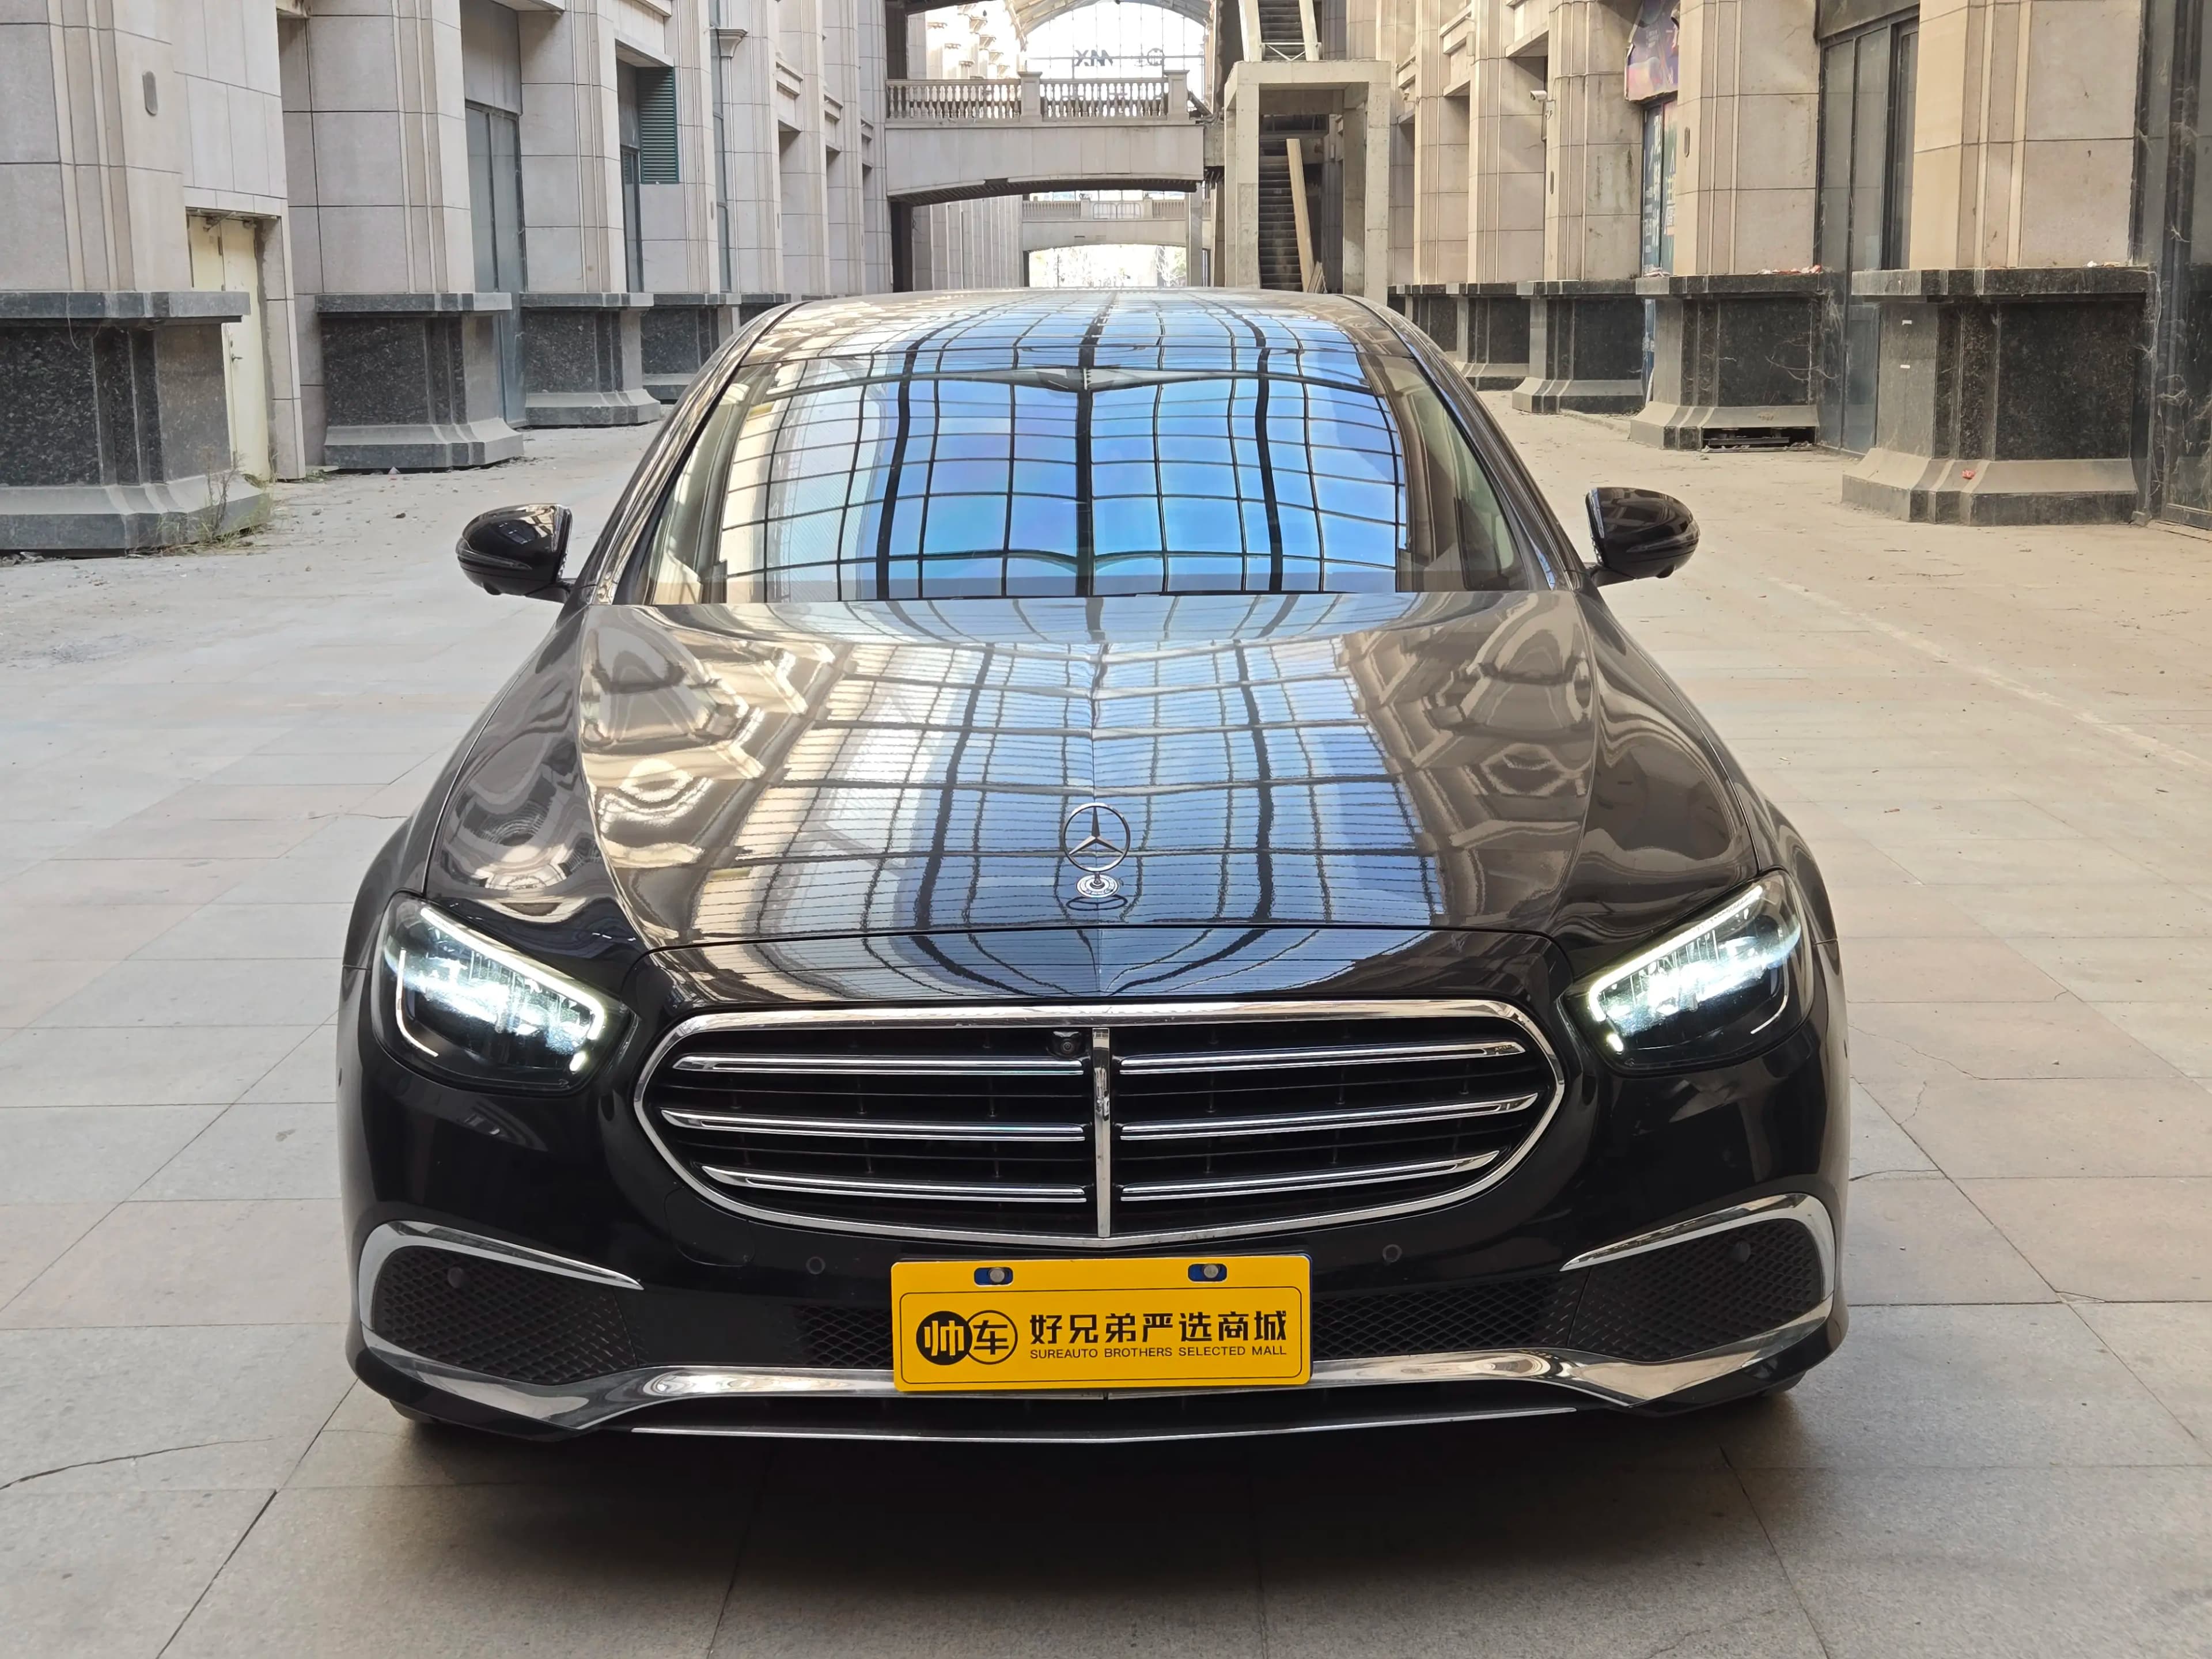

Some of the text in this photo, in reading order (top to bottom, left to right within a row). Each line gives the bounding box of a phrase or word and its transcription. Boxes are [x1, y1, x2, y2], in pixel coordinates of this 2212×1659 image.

[923, 1317, 1011, 1358] 帅车
[1029, 1310, 1286, 1344] 好兄弟严选商城
[1030, 1345, 1287, 1359] SUREAUTO BROTHERS SELECTED MALL
